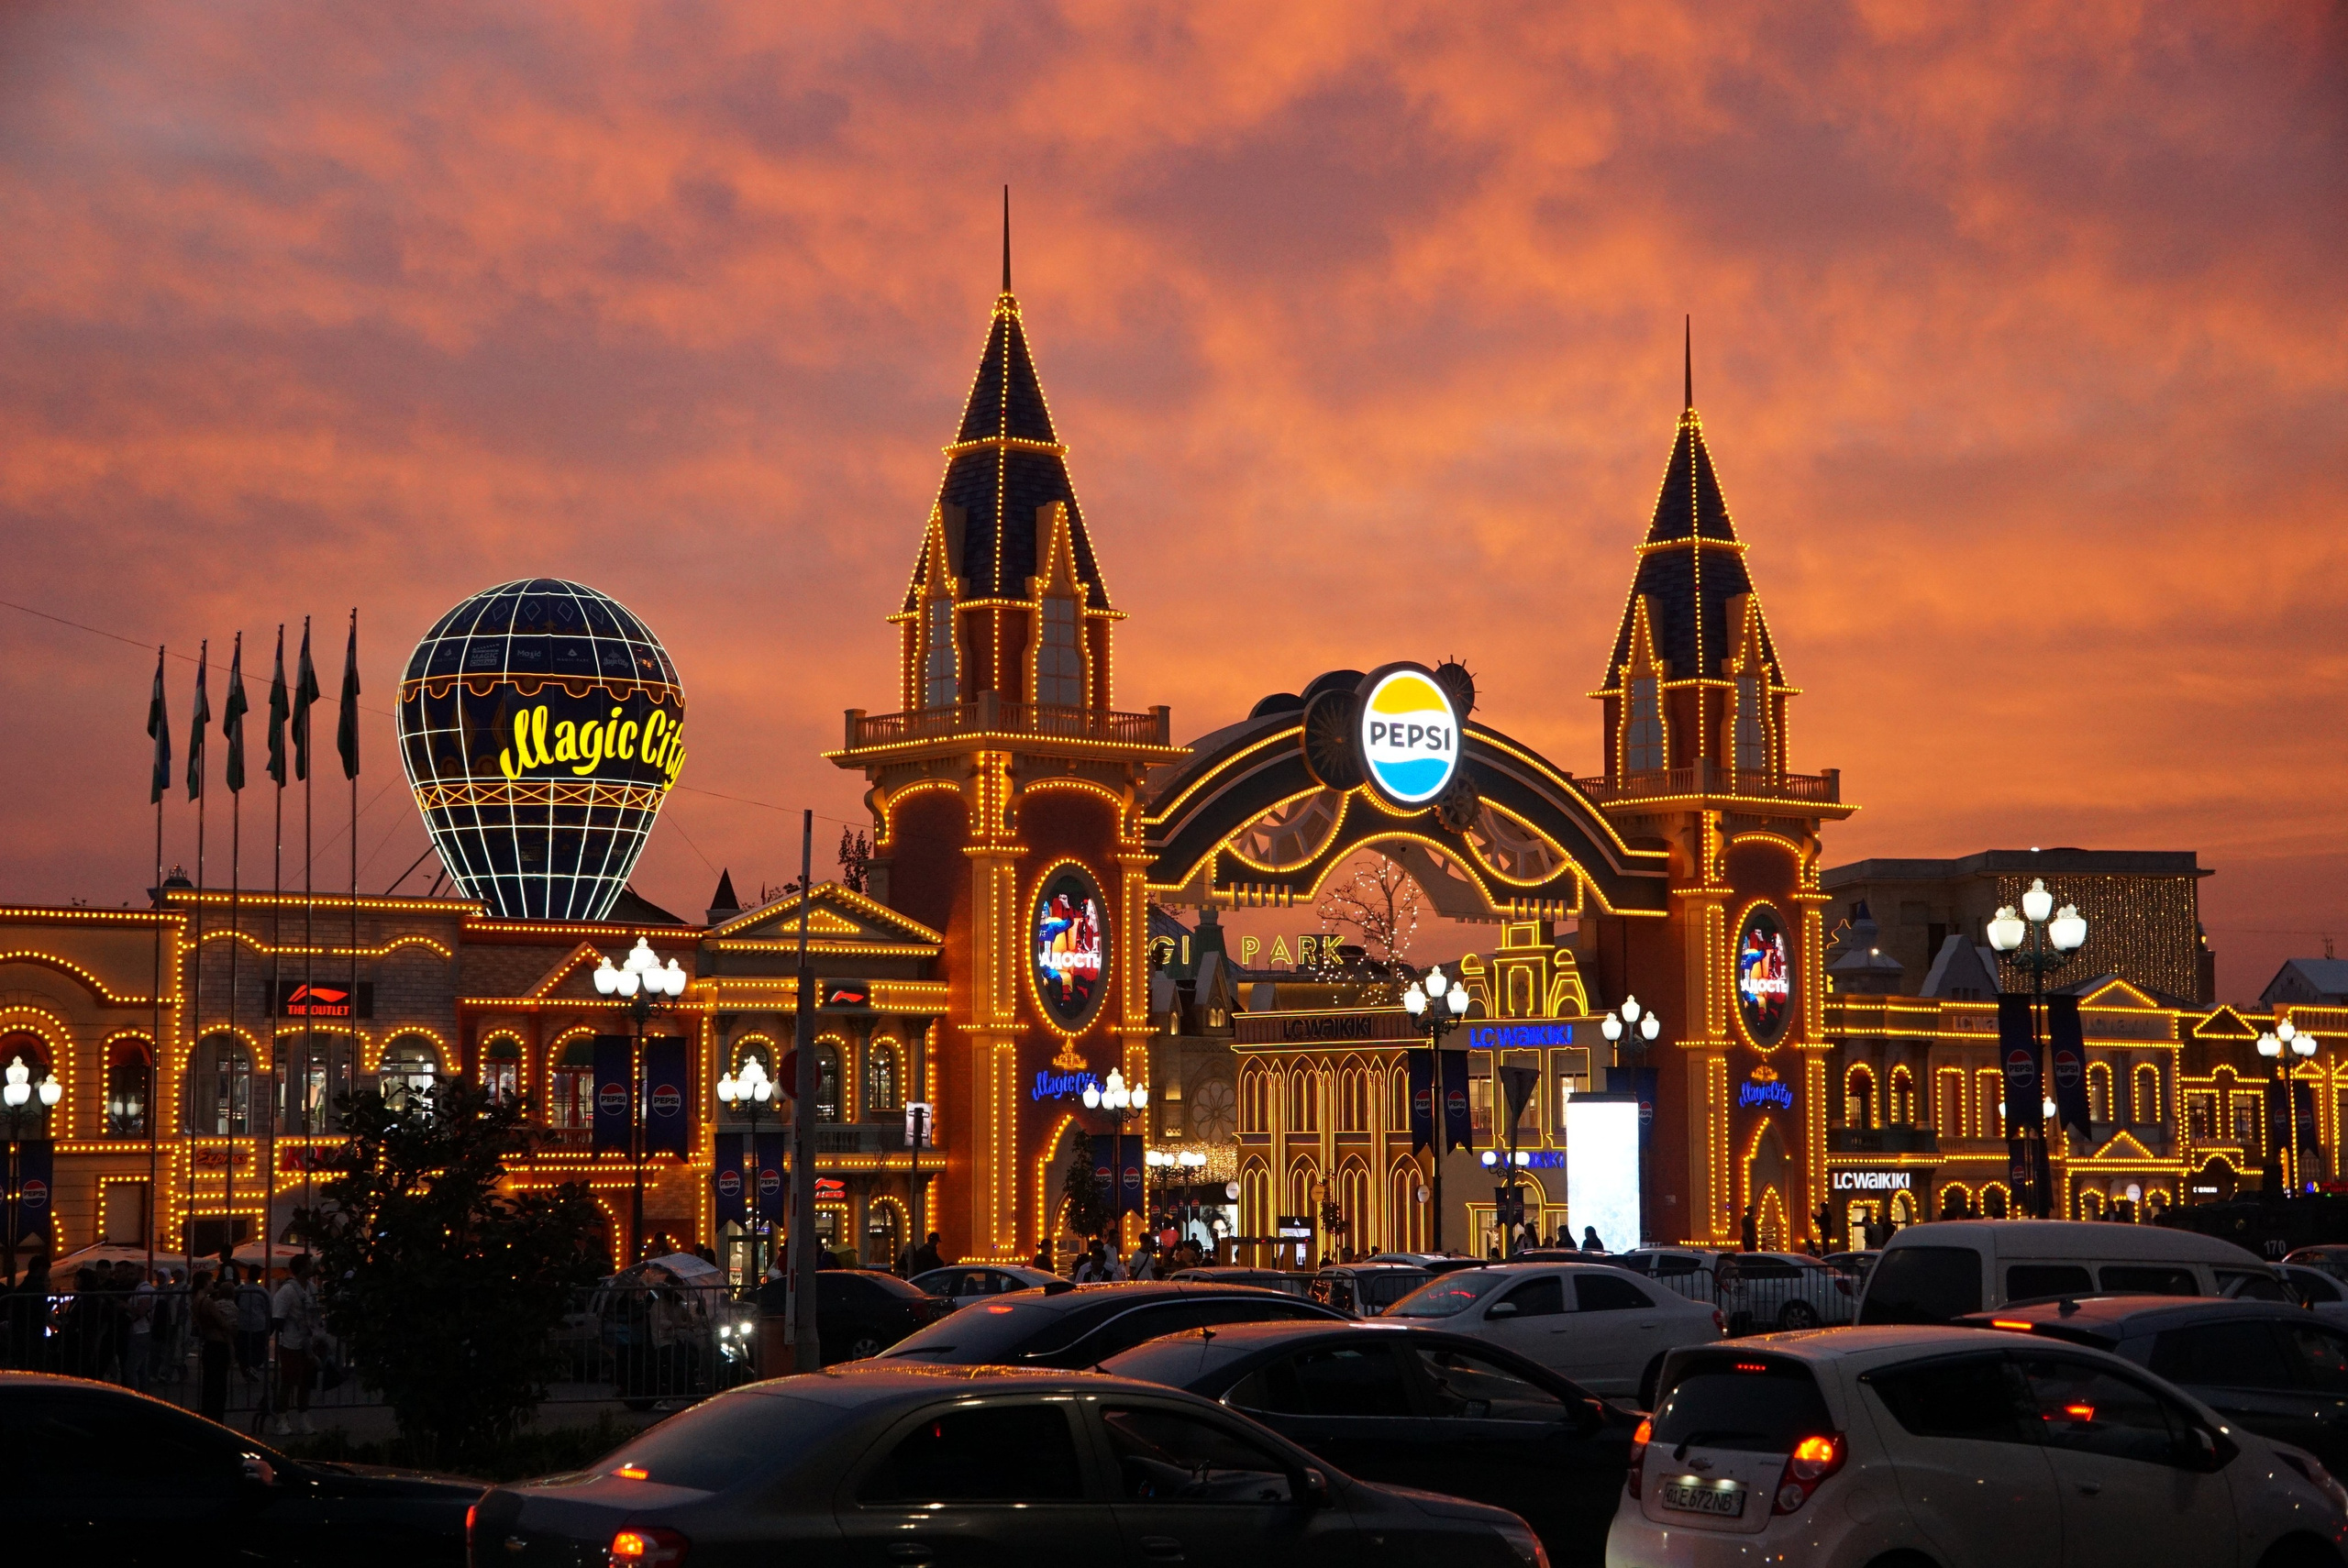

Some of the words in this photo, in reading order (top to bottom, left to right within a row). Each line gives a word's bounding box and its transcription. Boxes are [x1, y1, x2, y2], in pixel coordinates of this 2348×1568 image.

[1370, 721, 1450, 751] PEPSI
[500, 705, 638, 779] Magic
[641, 710, 687, 792] City
[1242, 934, 1346, 965] PARK
[1038, 952, 1101, 969] АДОСТЬ
[1740, 978, 1788, 994] АДОСТЬ
[310, 1005, 349, 1016] OUTLET
[1469, 1028, 1495, 1047] LC
[2009, 1064, 2033, 1073] PEPSI
[2056, 1065, 2078, 1073] PEPSI
[601, 1095, 626, 1103] PEPSI
[654, 1097, 679, 1105] PEPSI
[1833, 1172, 1854, 1189] LC
[2264, 1240, 2287, 1255] 170
